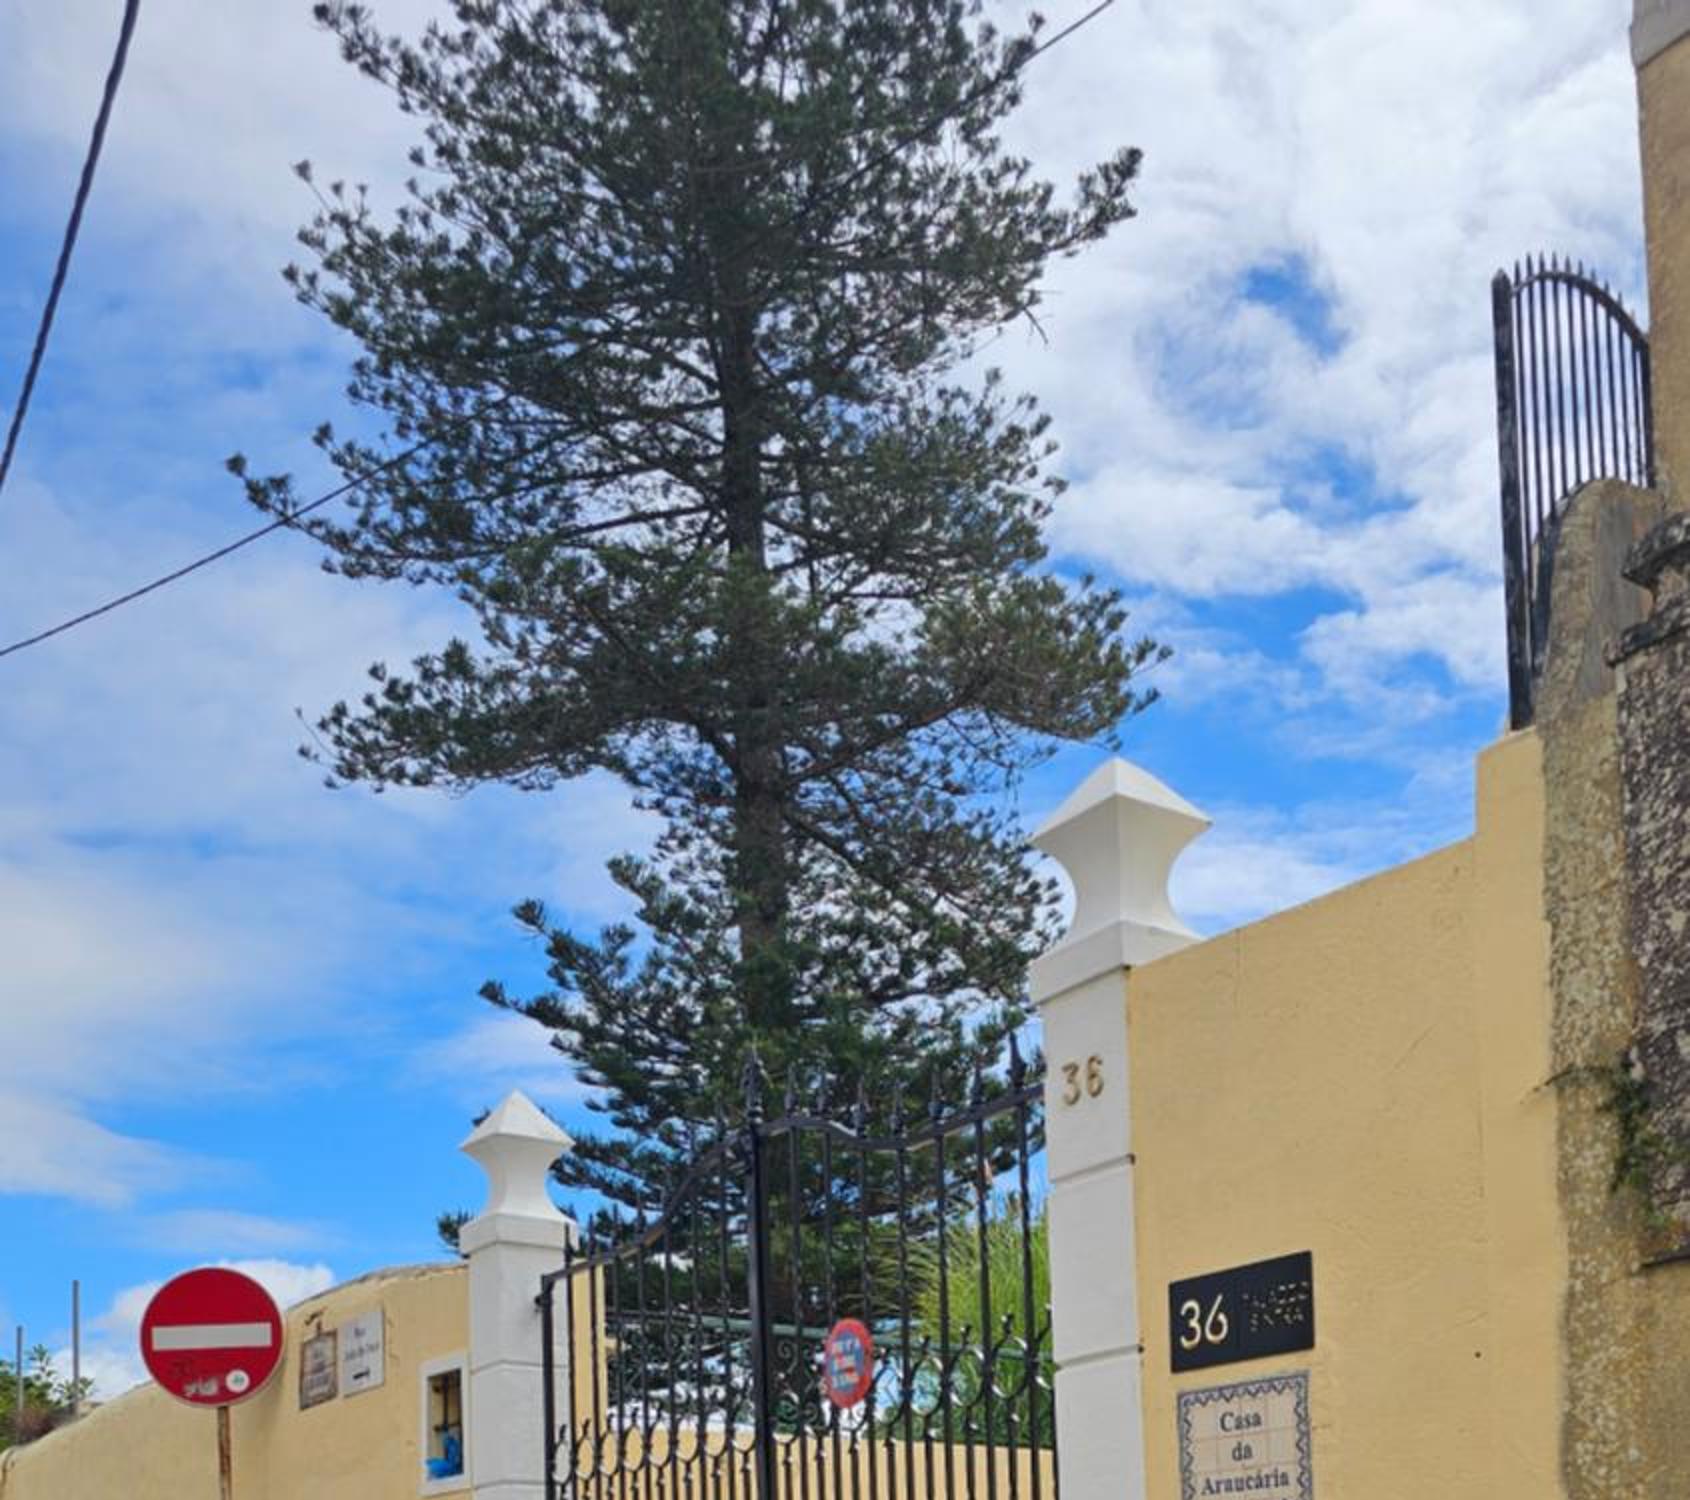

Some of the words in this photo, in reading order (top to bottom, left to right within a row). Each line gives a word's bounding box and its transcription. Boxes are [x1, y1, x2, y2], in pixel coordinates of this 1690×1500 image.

[1061, 1055, 1105, 1107] 36
[1180, 1293, 1228, 1350] 36
[1220, 1411, 1262, 1432] Casa
[1231, 1441, 1254, 1462] da
[1201, 1467, 1290, 1495] Araucária
